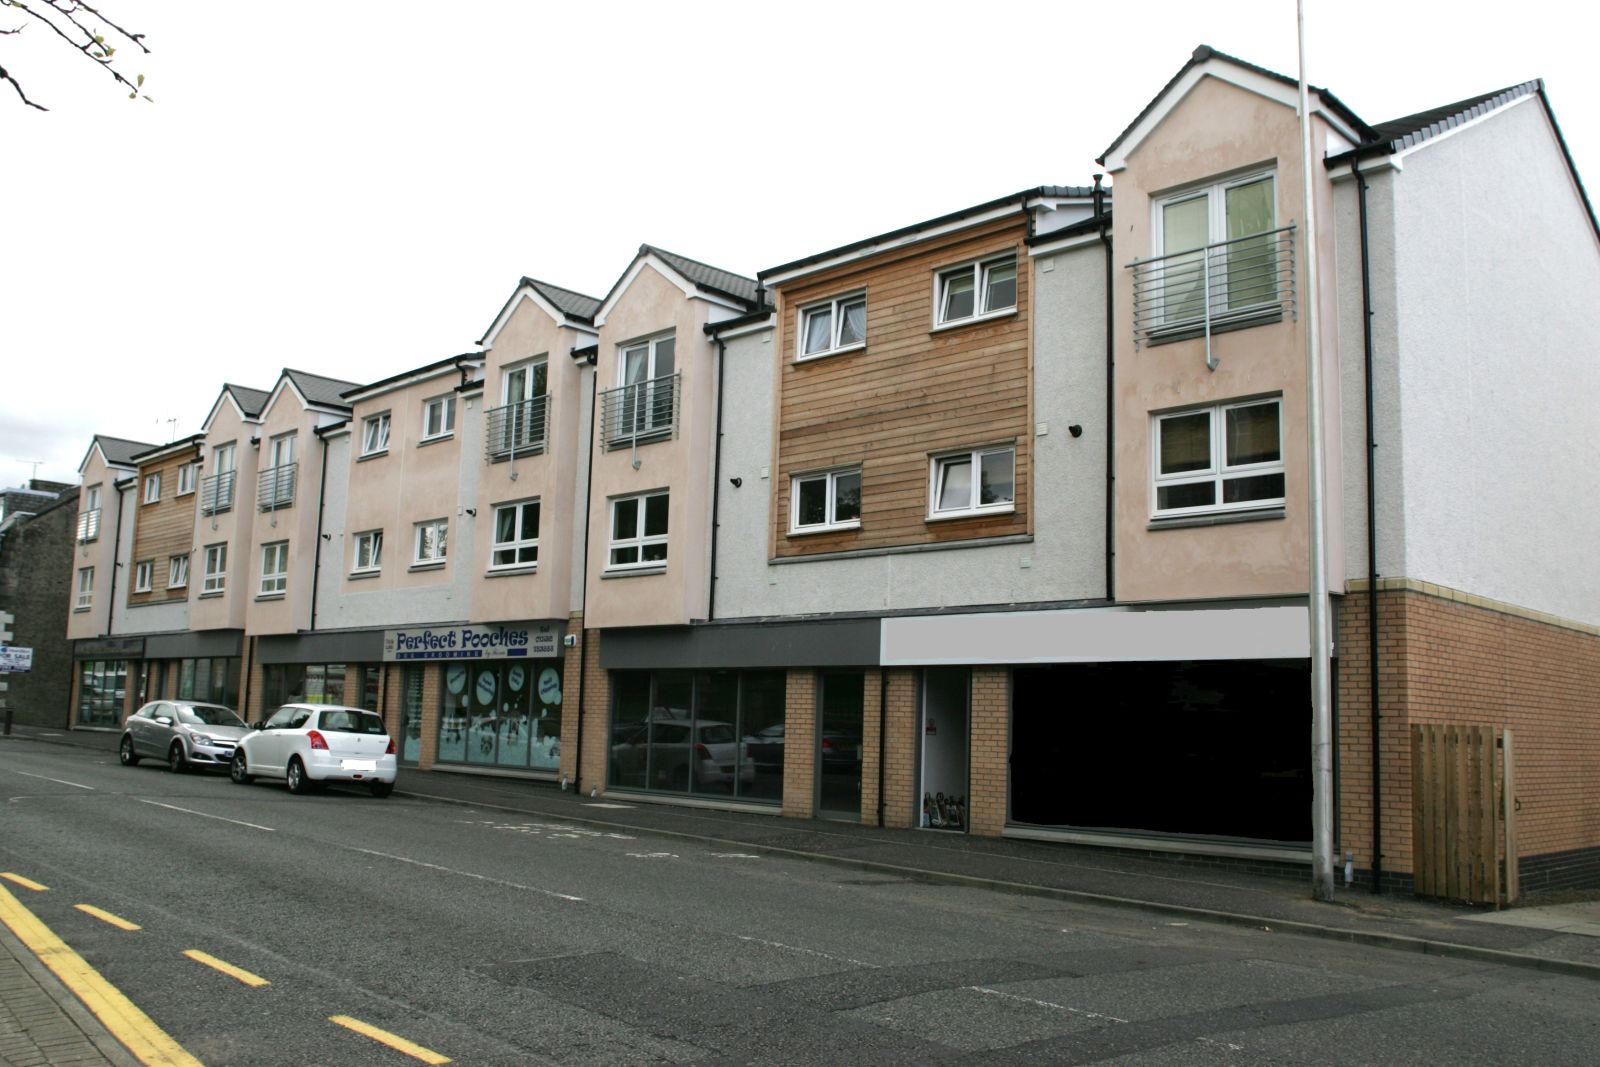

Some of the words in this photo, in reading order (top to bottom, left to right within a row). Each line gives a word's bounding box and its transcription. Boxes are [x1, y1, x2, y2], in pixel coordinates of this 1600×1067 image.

[397, 630, 456, 650] Perfect
[461, 626, 528, 648] Pooches
[424, 650, 479, 658] GROOMING
